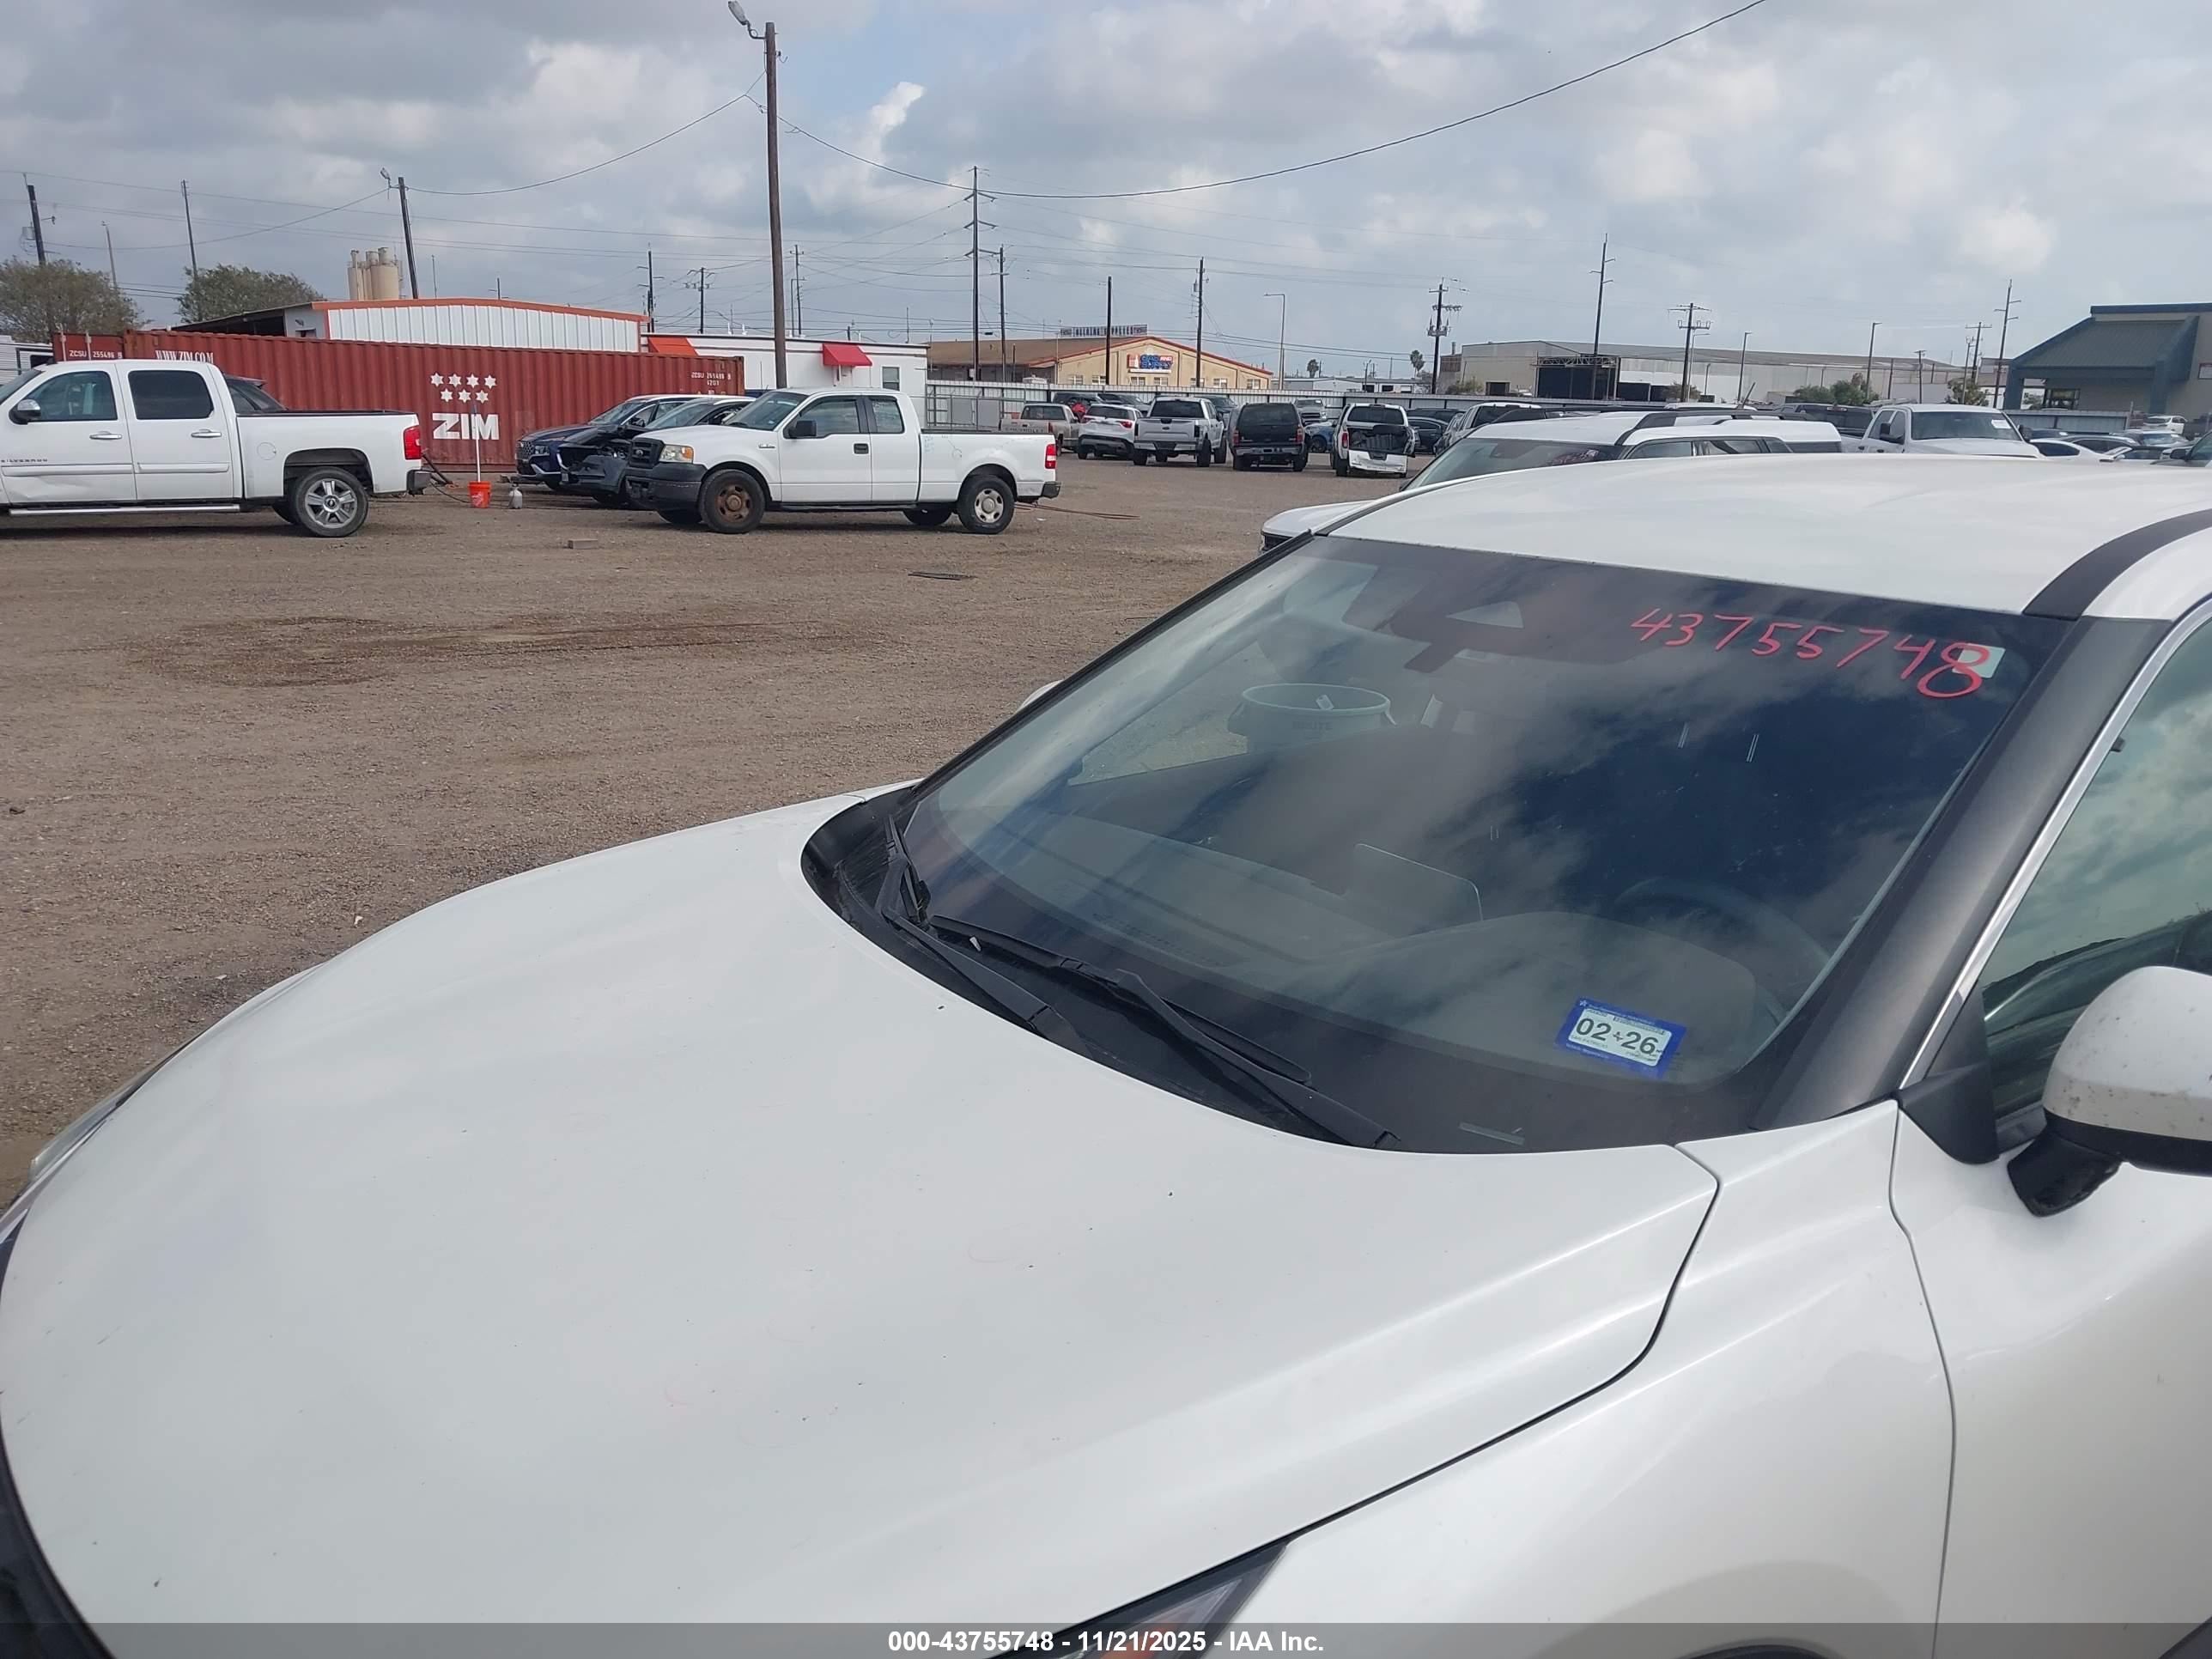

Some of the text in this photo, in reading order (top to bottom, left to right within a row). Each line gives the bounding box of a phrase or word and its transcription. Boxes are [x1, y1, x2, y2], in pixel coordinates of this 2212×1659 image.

[155, 349, 214, 364] WWWZIMCOM
[1140, 361, 1174, 369] SUPPLY
[432, 412, 500, 441] ZIM
[1631, 608, 1990, 698] 43755748
[1576, 1018, 1612, 1042] 02
[1620, 1030, 1659, 1054] 26
